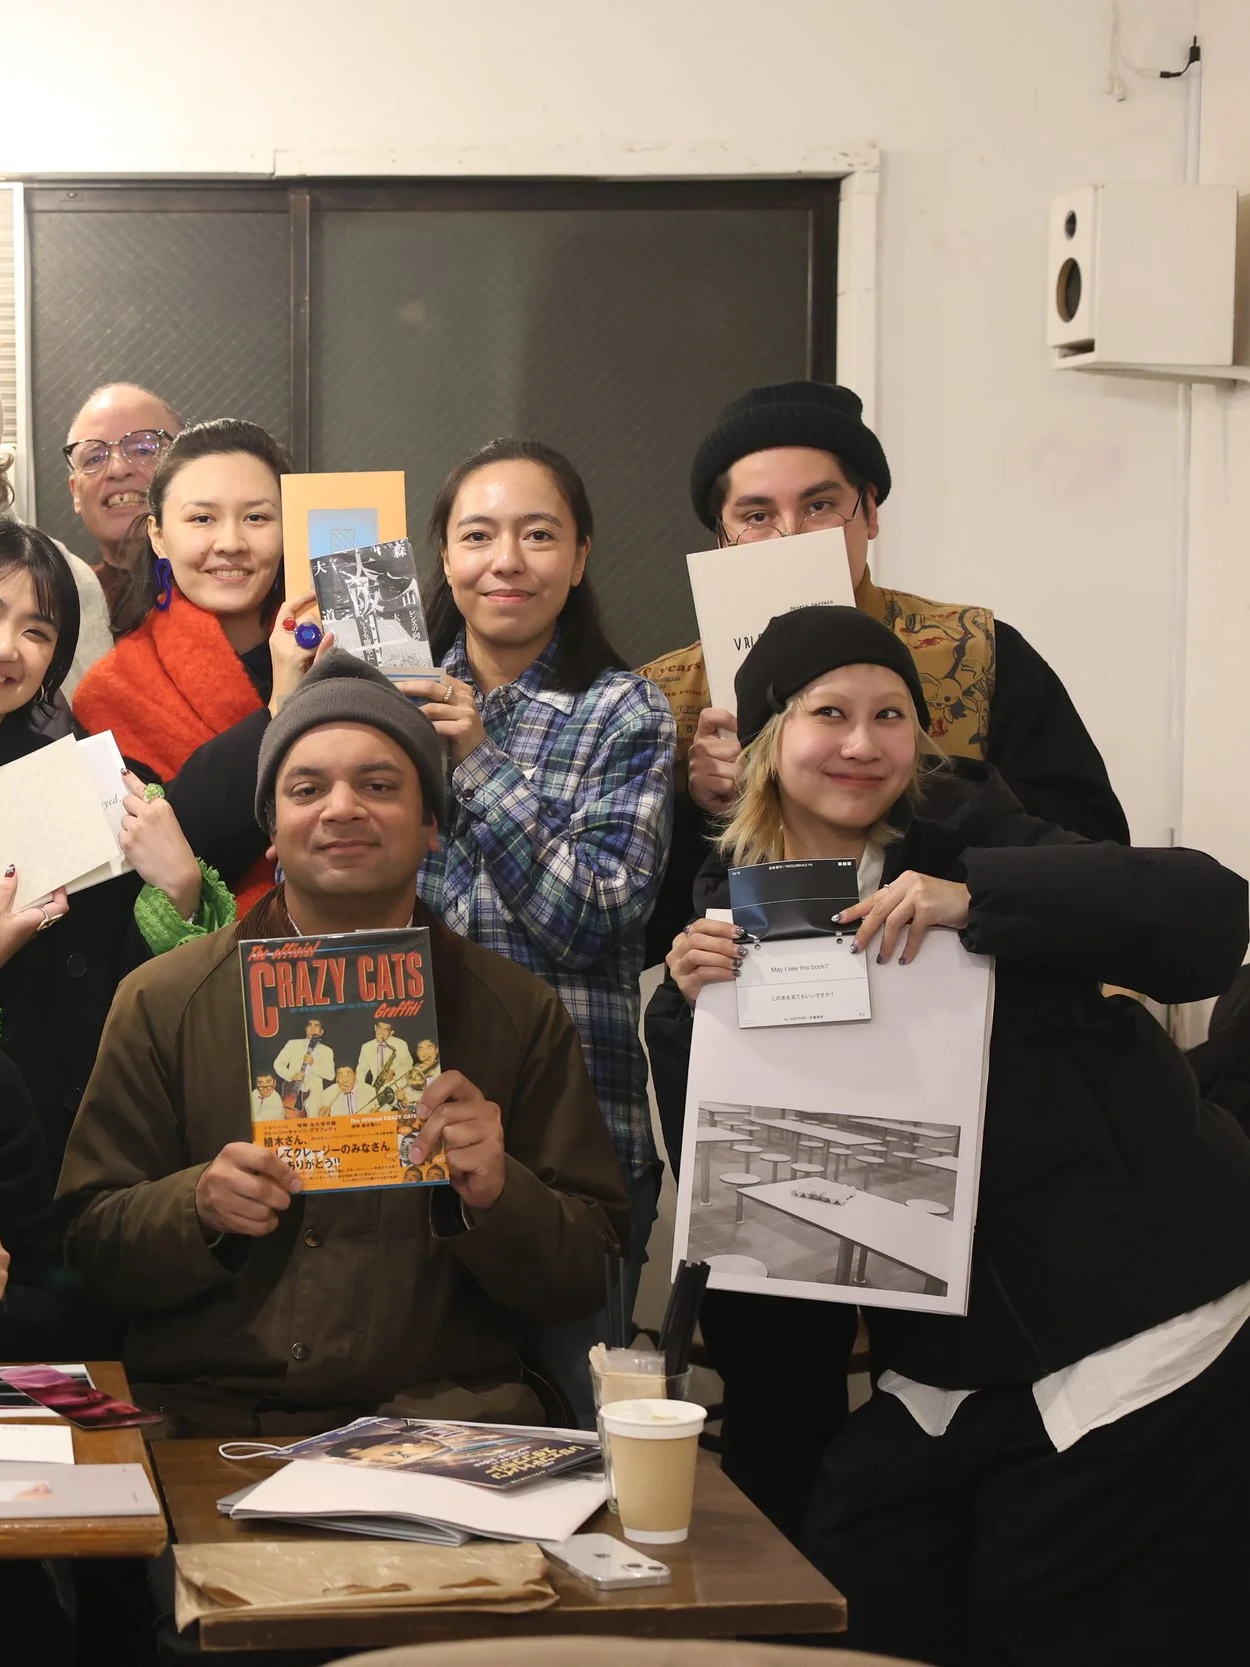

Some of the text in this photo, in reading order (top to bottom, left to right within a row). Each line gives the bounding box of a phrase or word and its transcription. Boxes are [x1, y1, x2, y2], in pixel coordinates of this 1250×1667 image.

[247, 945, 270, 961] The
[249, 952, 424, 1038] CRAZY CATS
[374, 1000, 424, 1018] Graffiti
